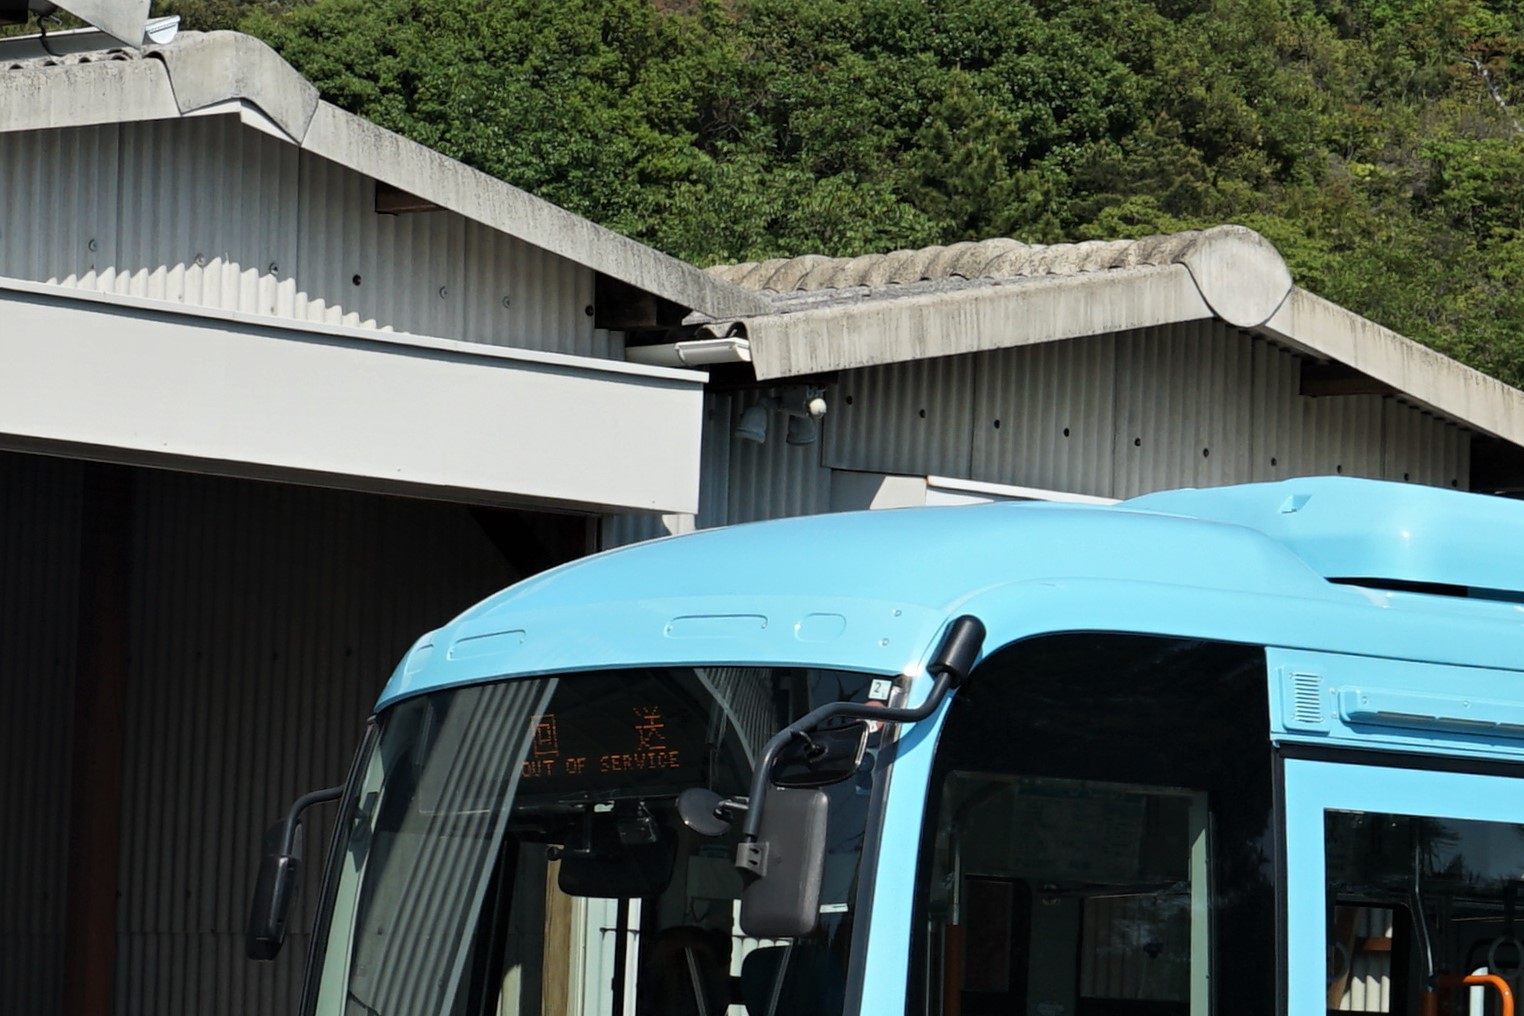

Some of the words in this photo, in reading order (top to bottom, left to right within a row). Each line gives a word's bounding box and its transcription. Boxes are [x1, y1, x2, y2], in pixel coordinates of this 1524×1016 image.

[522, 760, 554, 777] OUT
[566, 757, 586, 774] OF
[600, 751, 679, 772] SERVICE
